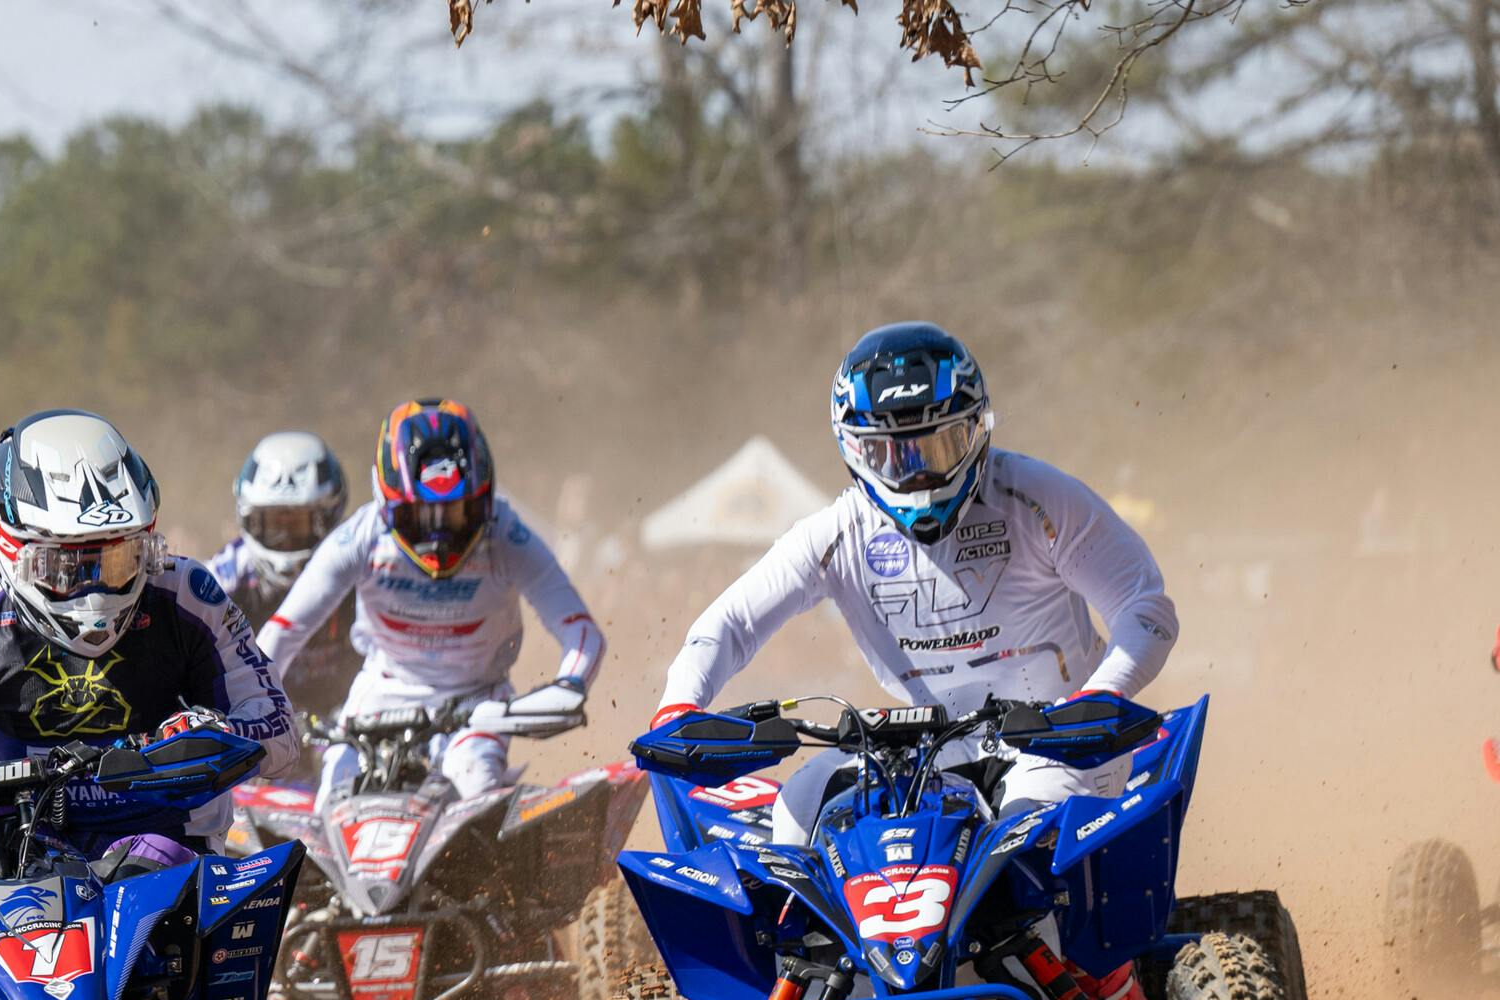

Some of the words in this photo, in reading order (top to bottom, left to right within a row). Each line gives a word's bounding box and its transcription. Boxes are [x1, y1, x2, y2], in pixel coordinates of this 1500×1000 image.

[877, 384, 930, 403] FLY
[352, 820, 419, 859] 15
[244, 897, 281, 910] ENDA
[859, 878, 951, 939] 3
[22, 931, 66, 976] 1
[350, 933, 419, 978] 15
